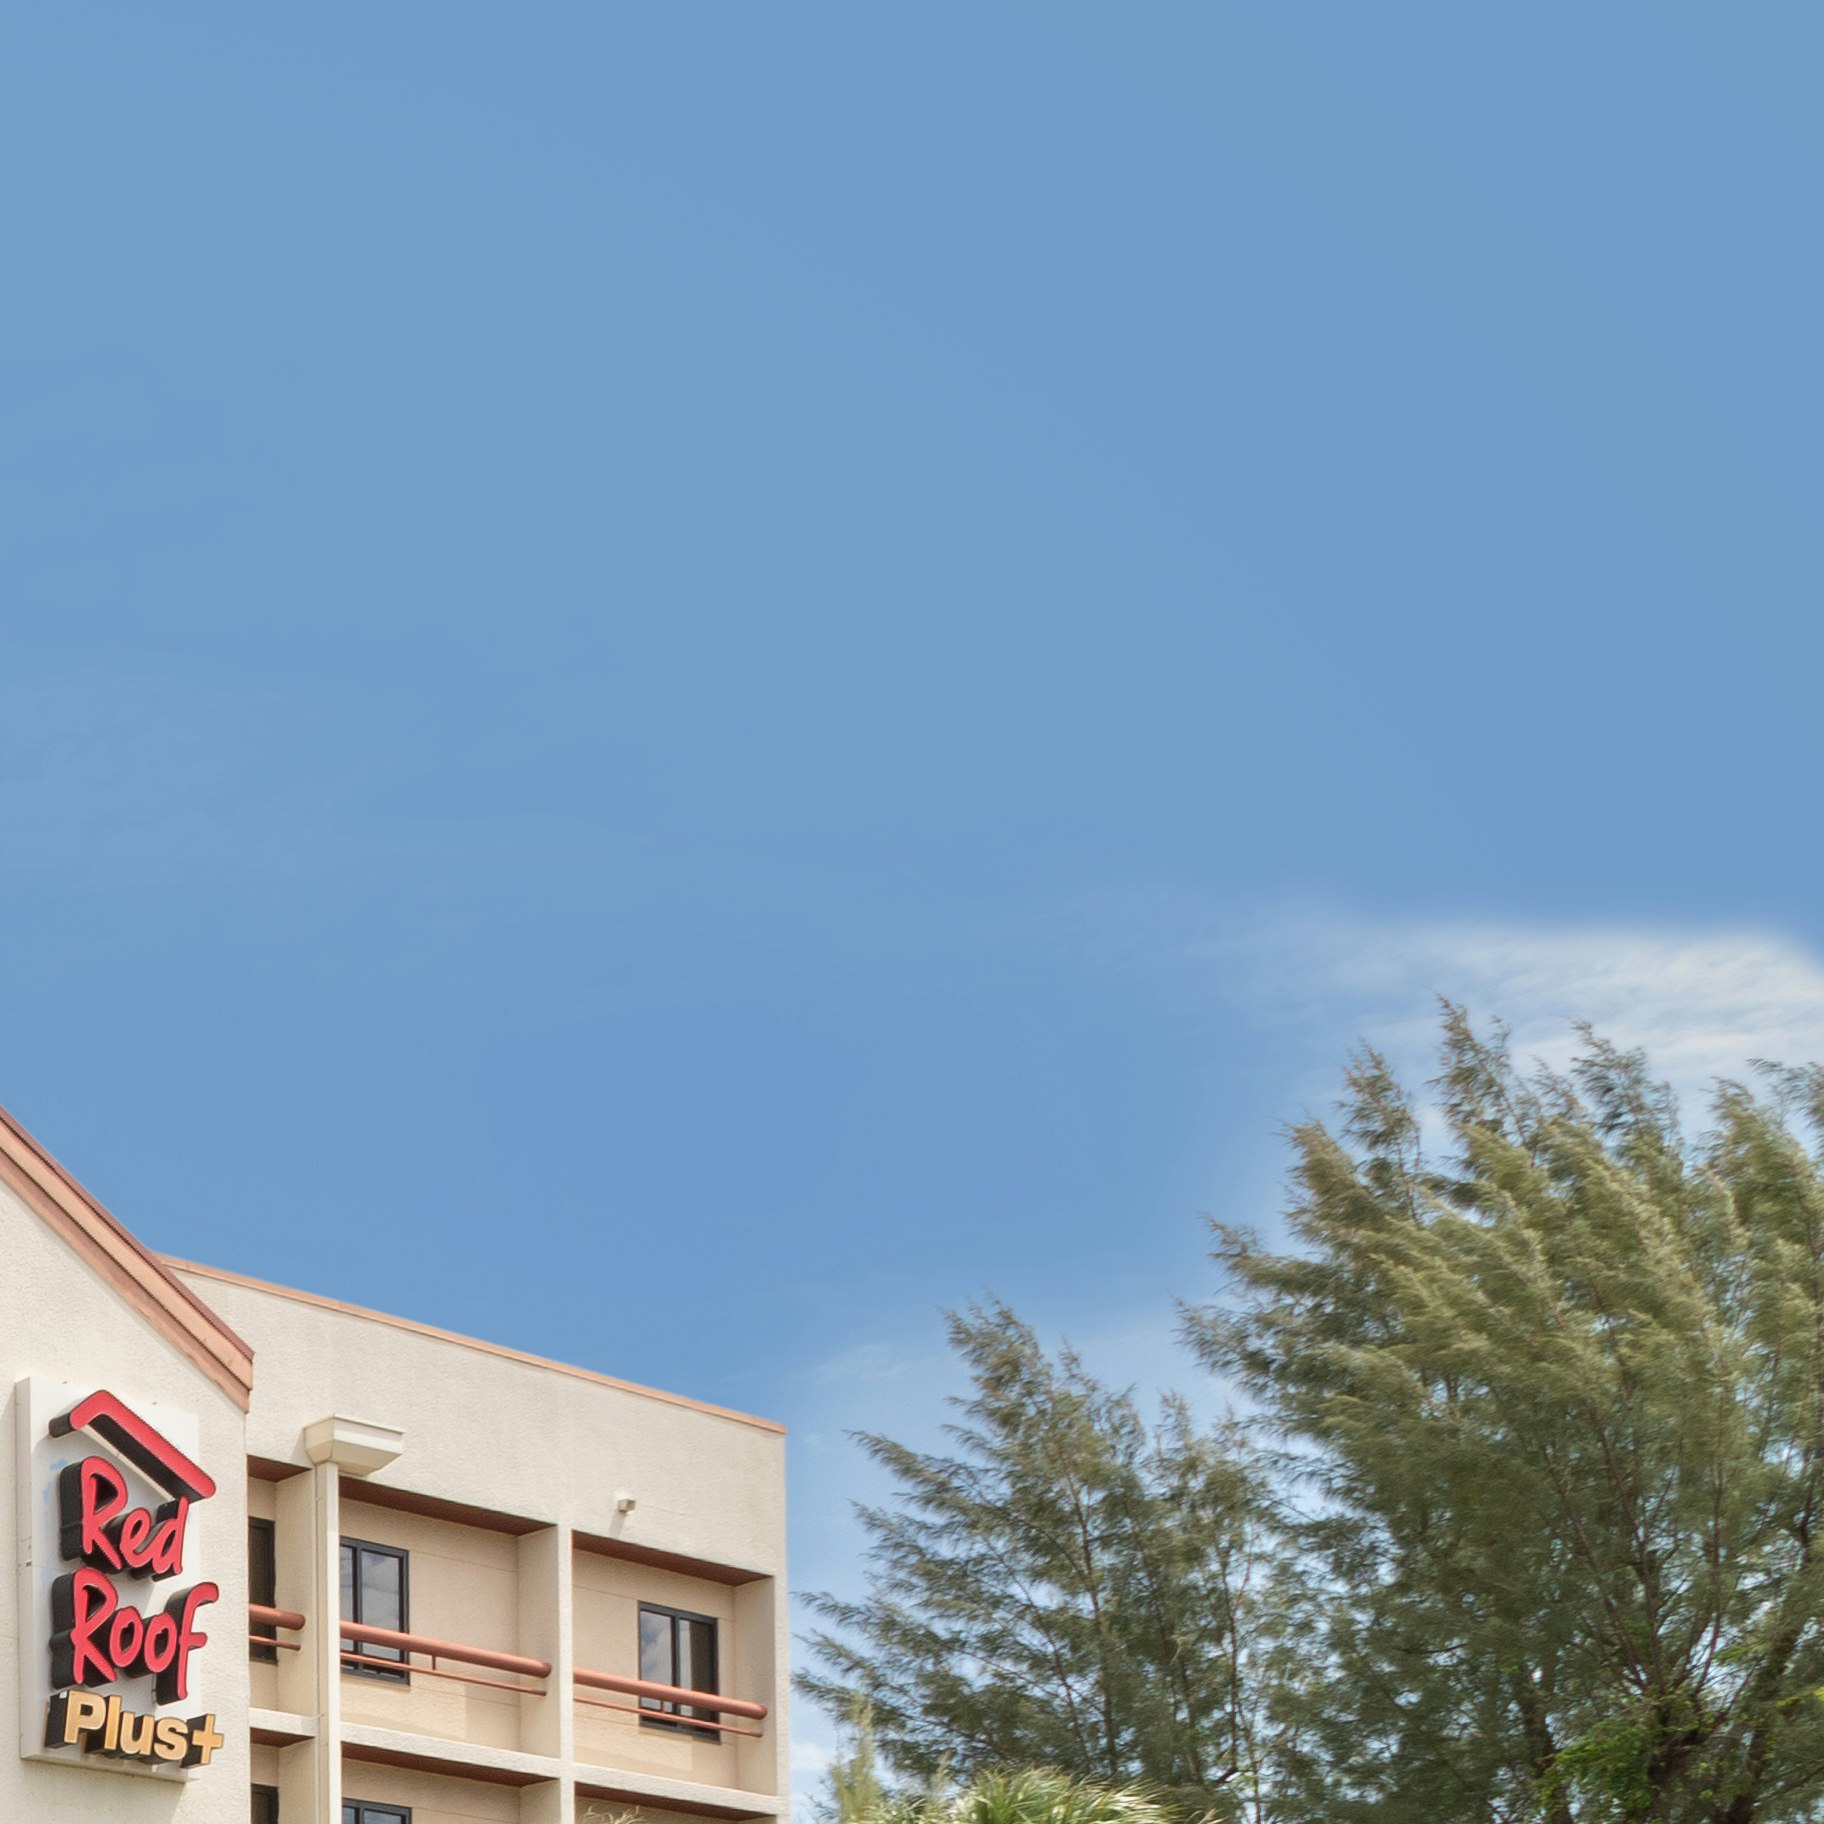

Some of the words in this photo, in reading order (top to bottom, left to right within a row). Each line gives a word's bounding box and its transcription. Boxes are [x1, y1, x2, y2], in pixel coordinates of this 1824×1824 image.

[80, 1455, 189, 1574] Red
[70, 1567, 220, 1700] Roof
[63, 1689, 225, 1766] Plus+
